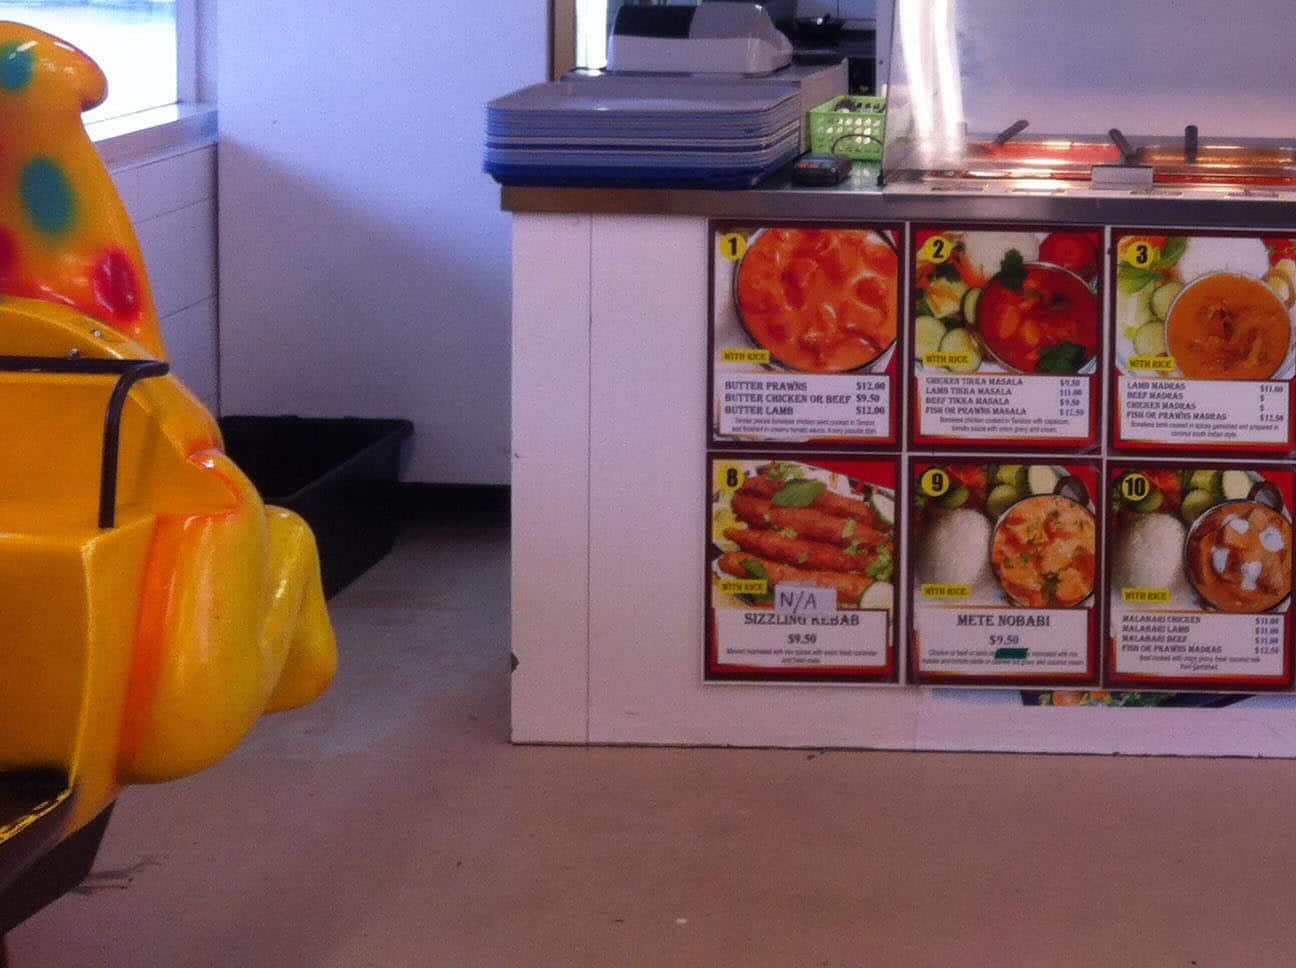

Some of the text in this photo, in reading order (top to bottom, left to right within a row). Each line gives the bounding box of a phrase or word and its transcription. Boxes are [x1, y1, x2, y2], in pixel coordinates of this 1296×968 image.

[729, 237, 737, 257] 1
[932, 239, 944, 258] 2
[1136, 244, 1147, 264] 3
[724, 381, 886, 391] BUTTER PRAWNS $12.00
[1127, 382, 1150, 390] LAMB
[1151, 382, 1186, 390] MADRAS
[724, 393, 881, 404] BUTTER CHICKEN OR BEEF $9.50
[1127, 392, 1184, 400] BEEF MADRAS
[724, 405, 764, 415] BUTTER
[765, 406, 794, 416] LAMB
[1126, 402, 1196, 410] CHICKEN MADRAS
[727, 468, 738, 488] 8
[932, 473, 943, 492] 9
[1124, 477, 1144, 496] 10
[780, 590, 817, 614] N/A
[743, 612, 860, 627] SIZZLING KEBAB
[956, 614, 1050, 627] METE NOBABI
[787, 633, 817, 645] $9.50
[988, 634, 1020, 646] $9.50
